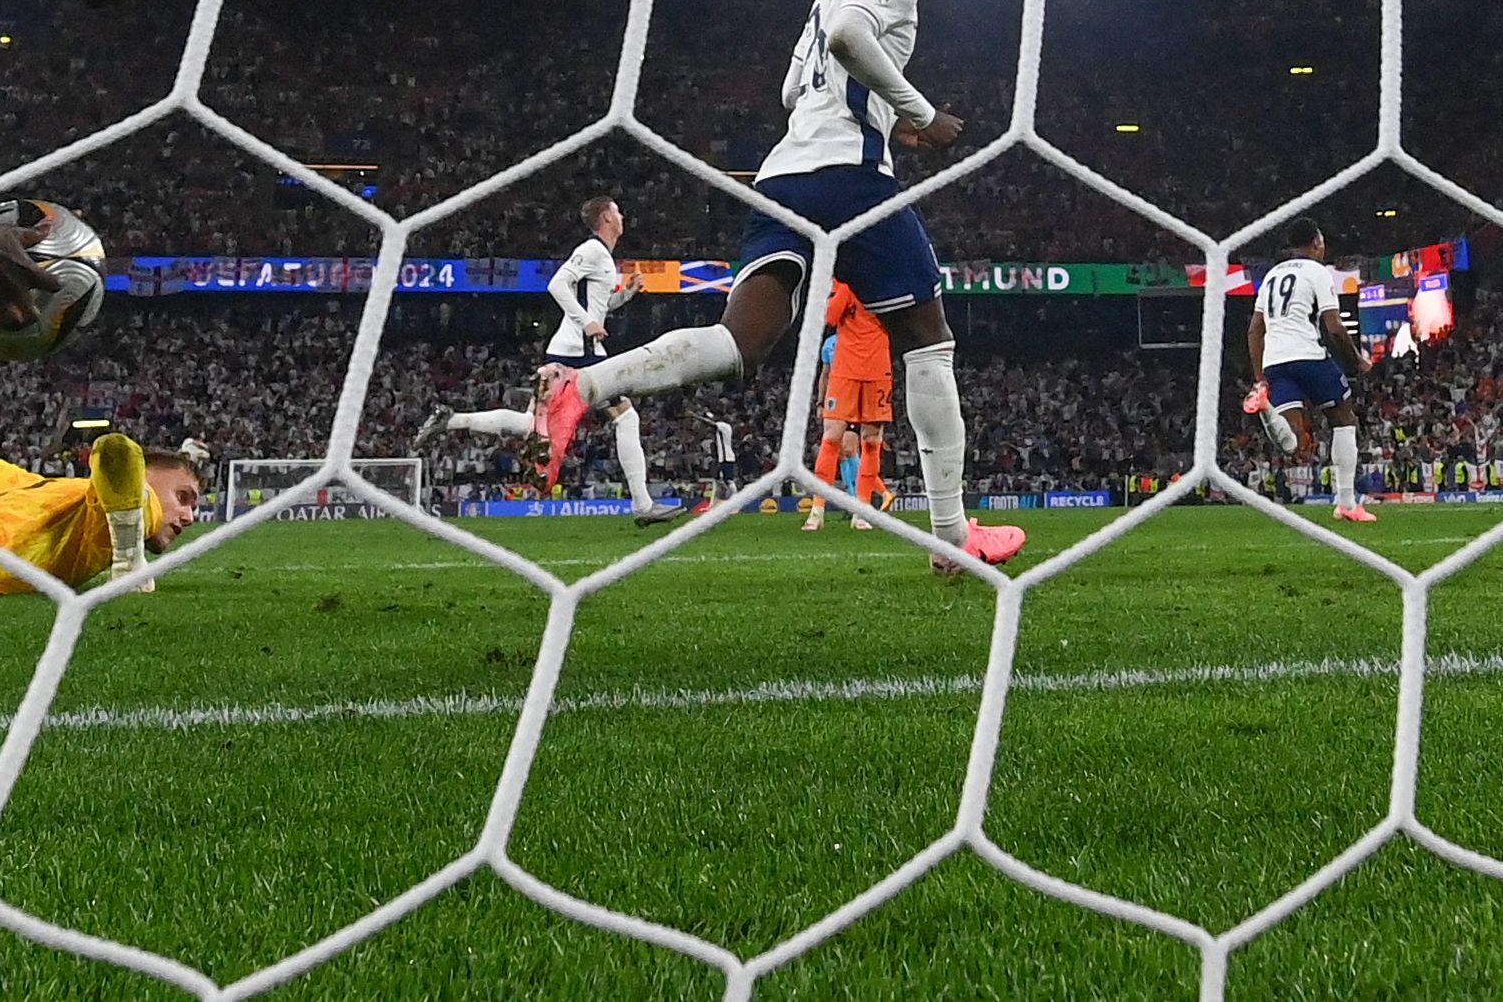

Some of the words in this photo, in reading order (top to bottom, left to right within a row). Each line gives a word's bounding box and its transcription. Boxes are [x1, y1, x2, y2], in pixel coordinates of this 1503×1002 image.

[381, 263, 455, 288] 024
[940, 266, 1070, 290] TMUND
[1266, 273, 1297, 319] 19
[276, 505, 346, 521] QATAR
[1050, 495, 1105, 507] RECYCLE
